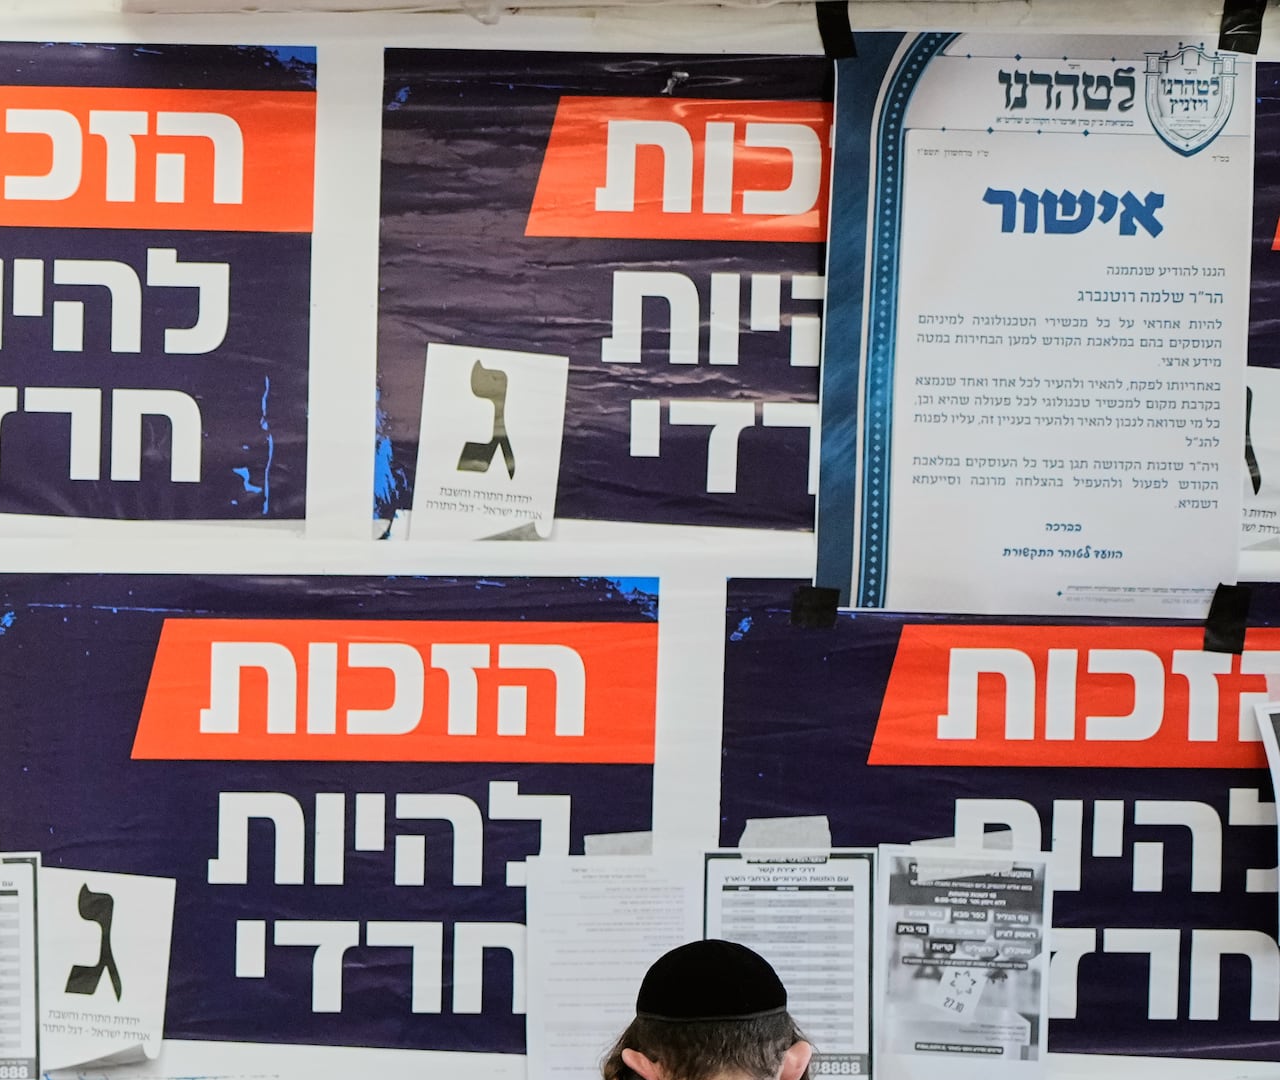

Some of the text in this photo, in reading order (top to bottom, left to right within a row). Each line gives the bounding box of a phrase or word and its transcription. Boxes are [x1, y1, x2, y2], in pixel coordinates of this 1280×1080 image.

[998, 67, 1135, 112] לטהרנו
[1161, 76, 1219, 95] לטהרנו
[595, 120, 821, 215] כות
[983, 188, 1165, 239] אישור
[1106, 265, 1226, 277] הננו להודיע שנתמנה
[1077, 290, 1136, 303] רוטנברג
[1139, 290, 1184, 304] שלמה
[602, 271, 825, 366] יות
[918, 313, 1222, 330] להיות אחראי על כל מכשירי הטכנולוגיה למיניהם
[917, 333, 1222, 351] העוסקים בהם במלאכת הקודש למען הבחירות במטה
[1192, 356, 1222, 368] מידע
[915, 376, 956, 387] שנמצא
[959, 376, 988, 388] ואחד
[992, 377, 1016, 388] אחד
[1019, 376, 1040, 389] לכל
[1043, 378, 1084, 390] ולהעיר
[1087, 378, 1123, 390] להאיר
[1166, 381, 1221, 392] באחריותו
[938, 393, 970, 406] שהיא
[974, 394, 1011, 407] פעולה
[1015, 395, 1037, 407] לכל
[1041, 396, 1090, 409] טכנולוגי
[1095, 397, 1141, 409] למכשיר
[1146, 398, 1177, 410] מקום
[1180, 399, 1221, 412] בקרבת
[457, 360, 515, 480] ג
[913, 411, 948, 424] לפנות
[950, 412, 975, 425] עליו
[997, 414, 1032, 428] בעניין
[1034, 414, 1075, 427] ולהעיר
[1077, 415, 1112, 427] להאיר
[1115, 415, 1144, 430] לנכון
[1146, 416, 1187, 428] שרואה
[1190, 417, 1203, 429] מי
[1205, 417, 1220, 430] כל
[912, 455, 961, 467] במלאכת
[966, 457, 1018, 470] העוסקים
[1022, 457, 1037, 469] כל
[1042, 458, 1064, 469] בעד
[1069, 459, 1089, 470] תגן
[1093, 460, 1141, 473] הקדושה
[1146, 460, 1184, 472] שזכות
[911, 474, 1219, 493] הקודש לפעול ולהעפיל בהצלחה מרובה וסייעתא
[1045, 521, 1082, 532] בברכה
[1002, 545, 1123, 560] הוועד לטוהר התקשורת
[200, 642, 585, 736] הזכות
[938, 648, 1268, 742] זכות
[208, 781, 571, 887] להיות
[65, 883, 122, 1002] ג
[236, 920, 526, 1014] חרדי
